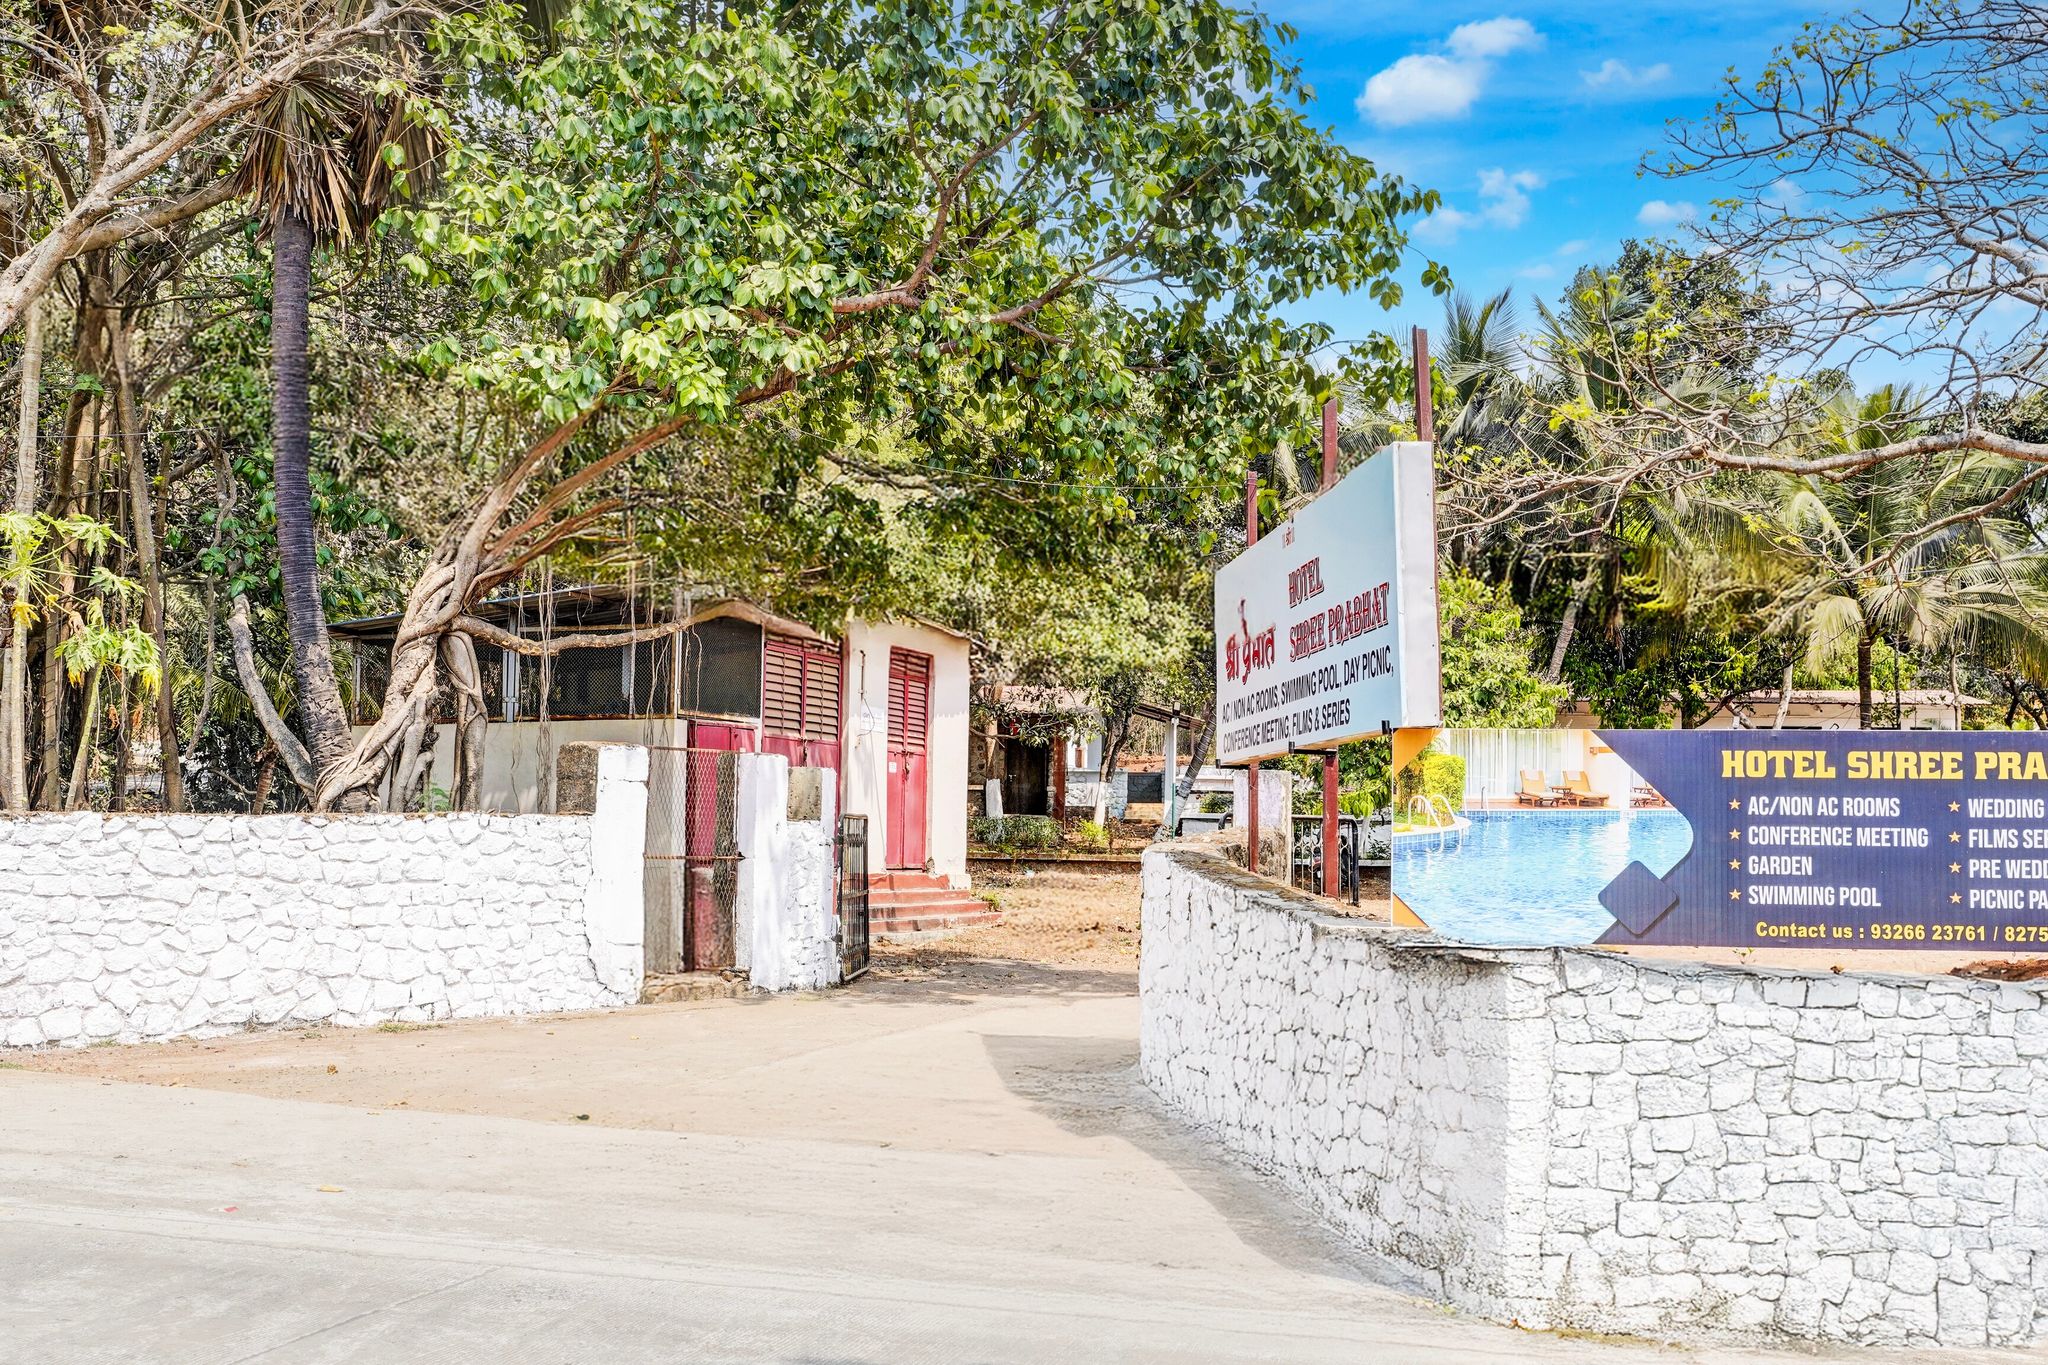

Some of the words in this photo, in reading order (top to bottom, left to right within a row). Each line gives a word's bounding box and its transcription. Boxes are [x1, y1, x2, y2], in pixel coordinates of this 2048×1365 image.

[1288, 557, 1324, 608] HOTEL
[1289, 612, 1326, 662] SHREE
[1328, 582, 1389, 647] PRABHAT
[1222, 702, 1230, 723] AC
[1234, 697, 1245, 720] NON
[1246, 694, 1255, 716] AC
[1256, 684, 1280, 710] ROOMS,
[1281, 671, 1316, 705] SWIMMING
[1318, 664, 1342, 692] POOL,
[1344, 655, 1360, 686] DAY
[1363, 645, 1394, 680] PICNIC,
[1223, 724, 1260, 753] CONFERENCE
[1292, 708, 1312, 736] FILMS
[1314, 706, 1319, 731] &
[1322, 698, 1350, 730] SERIES
[1721, 750, 1836, 779] HOTEL
[1847, 751, 1964, 780] SHREE
[1974, 751, 2048, 780] PRA
[1748, 796, 1813, 817] AC/NON
[1817, 797, 1839, 817] AC
[1843, 797, 1901, 817] ROOMS
[1967, 798, 2045, 819] WEDDING
[1748, 826, 1852, 847] CONFERENCE
[1856, 827, 1929, 848] MEETING
[1968, 828, 2019, 849] FILMS
[1748, 856, 1813, 876] GARDEN
[1969, 859, 2002, 879] PRE
[1748, 885, 1835, 906] SWIMMING
[1839, 886, 1882, 907] POOL
[1969, 889, 2025, 910] PICNIC
[1756, 921, 1826, 939] Contact
[1832, 924, 1853, 939] us
[1870, 923, 1926, 941] 93266
[1931, 924, 1986, 941] 23761
[1993, 925, 1999, 942] /
[2004, 925, 2048, 942] 8275
